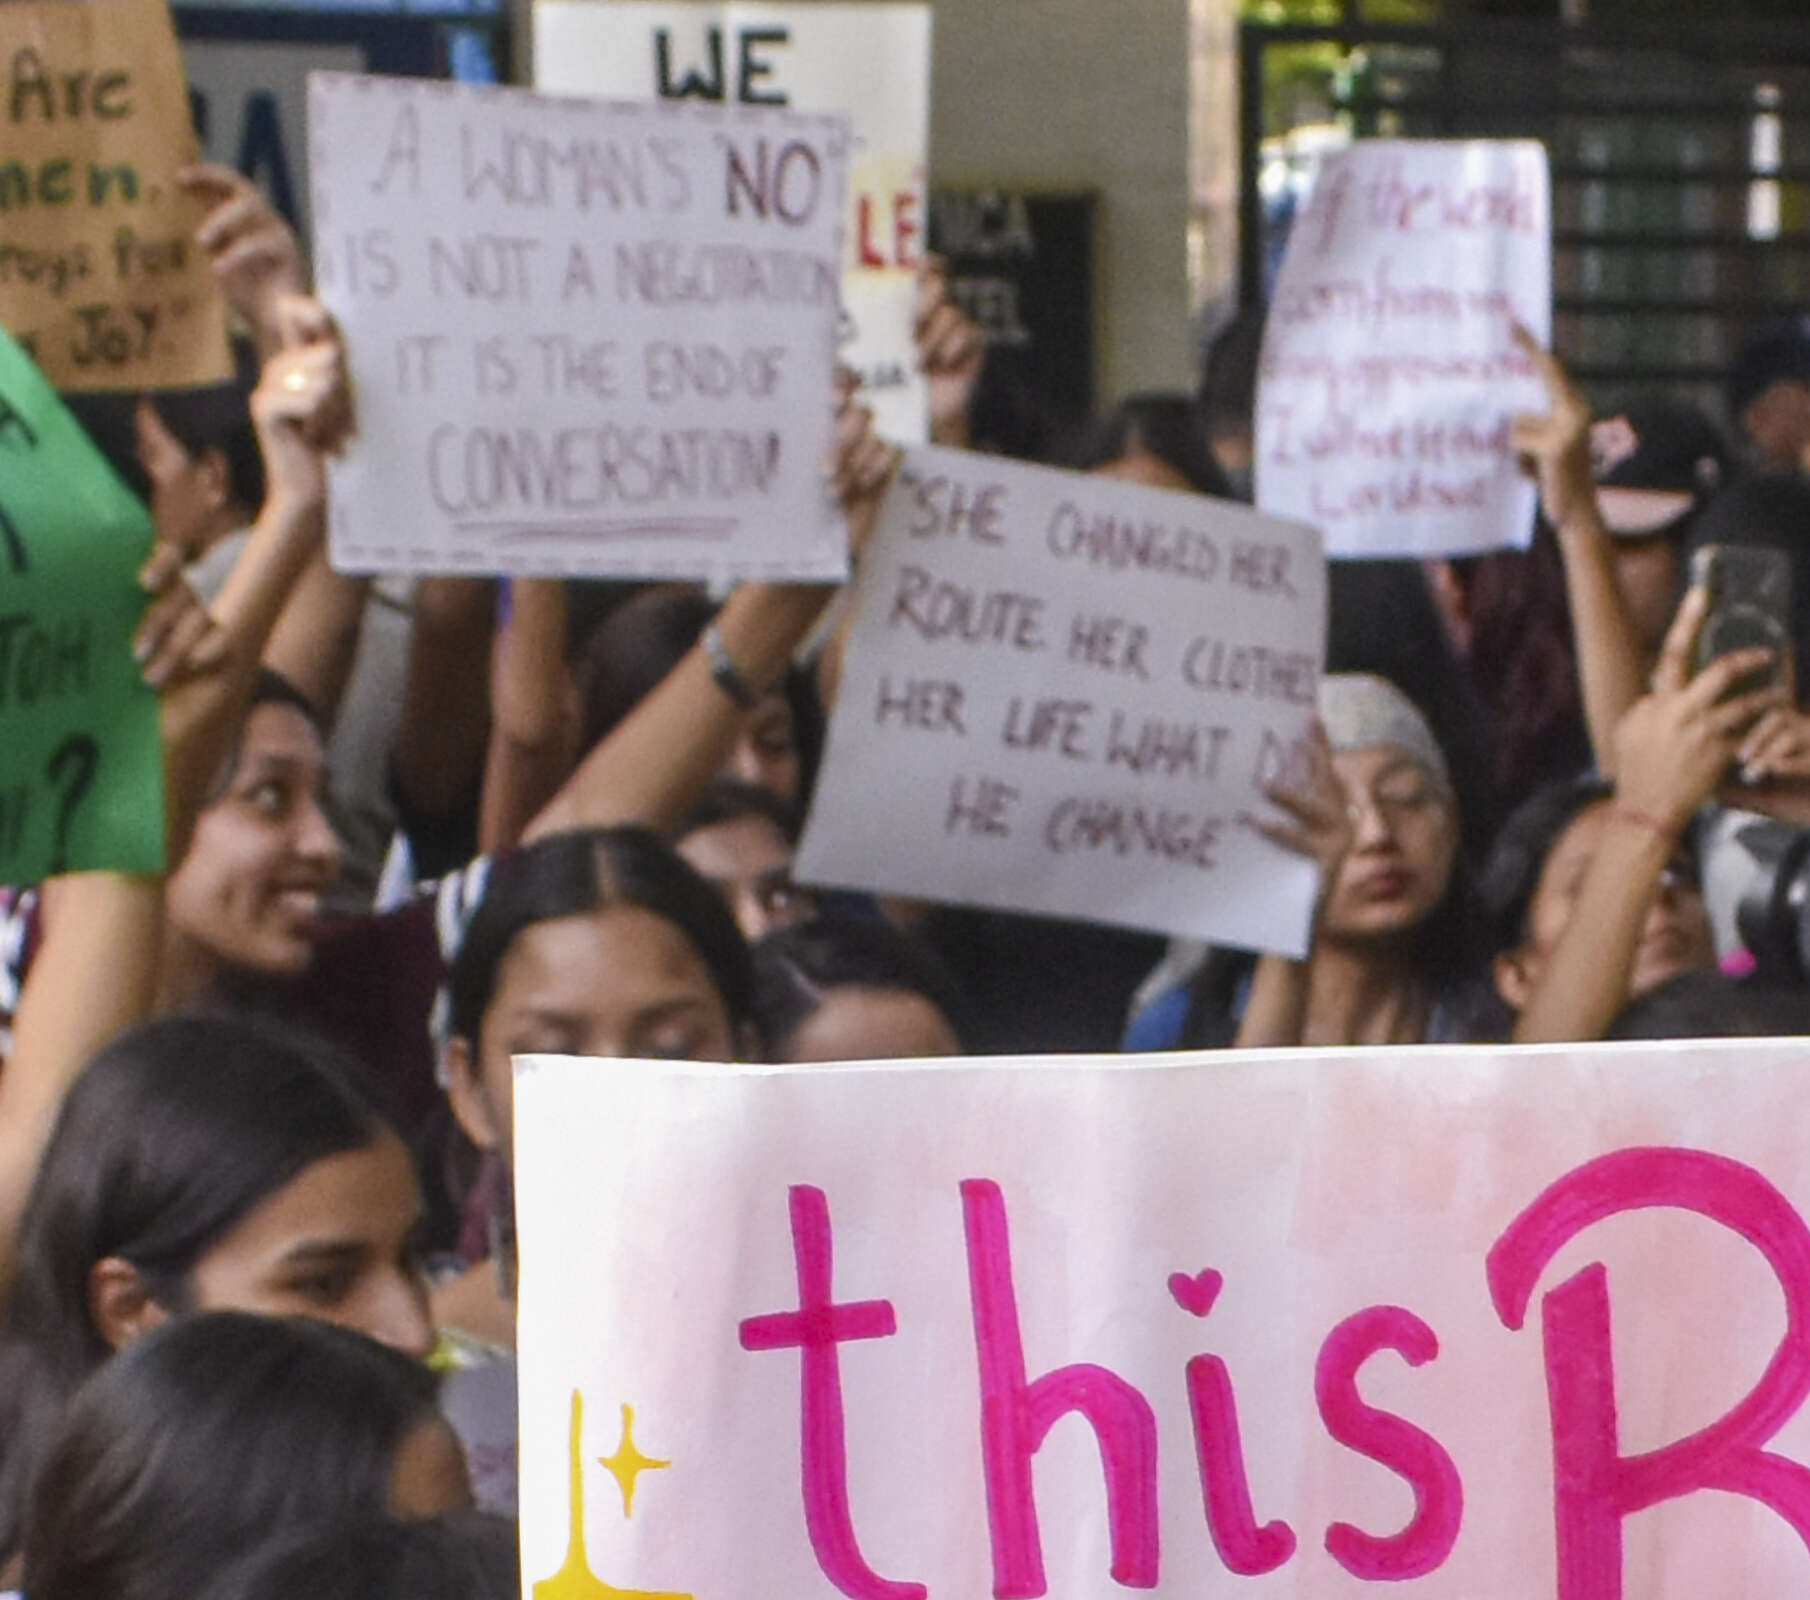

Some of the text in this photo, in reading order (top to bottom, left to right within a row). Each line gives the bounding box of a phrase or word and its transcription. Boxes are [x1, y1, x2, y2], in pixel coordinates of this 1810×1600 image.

[654, 26, 790, 107] WE
[369, 100, 423, 194] A
[346, 229, 399, 296] IS
[428, 235, 543, 302] NOT
[561, 244, 601, 302] A
[398, 335, 788, 402] IT IS THE END OF
[1229, 543, 1301, 600] HER
[888, 567, 1047, 651] ROUTE
[1068, 614, 1149, 680] HER
[875, 677, 965, 737] HER
[1004, 698, 1095, 761] LIFE
[1106, 711, 1230, 781] WHAT
[945, 774, 1019, 837] HE
